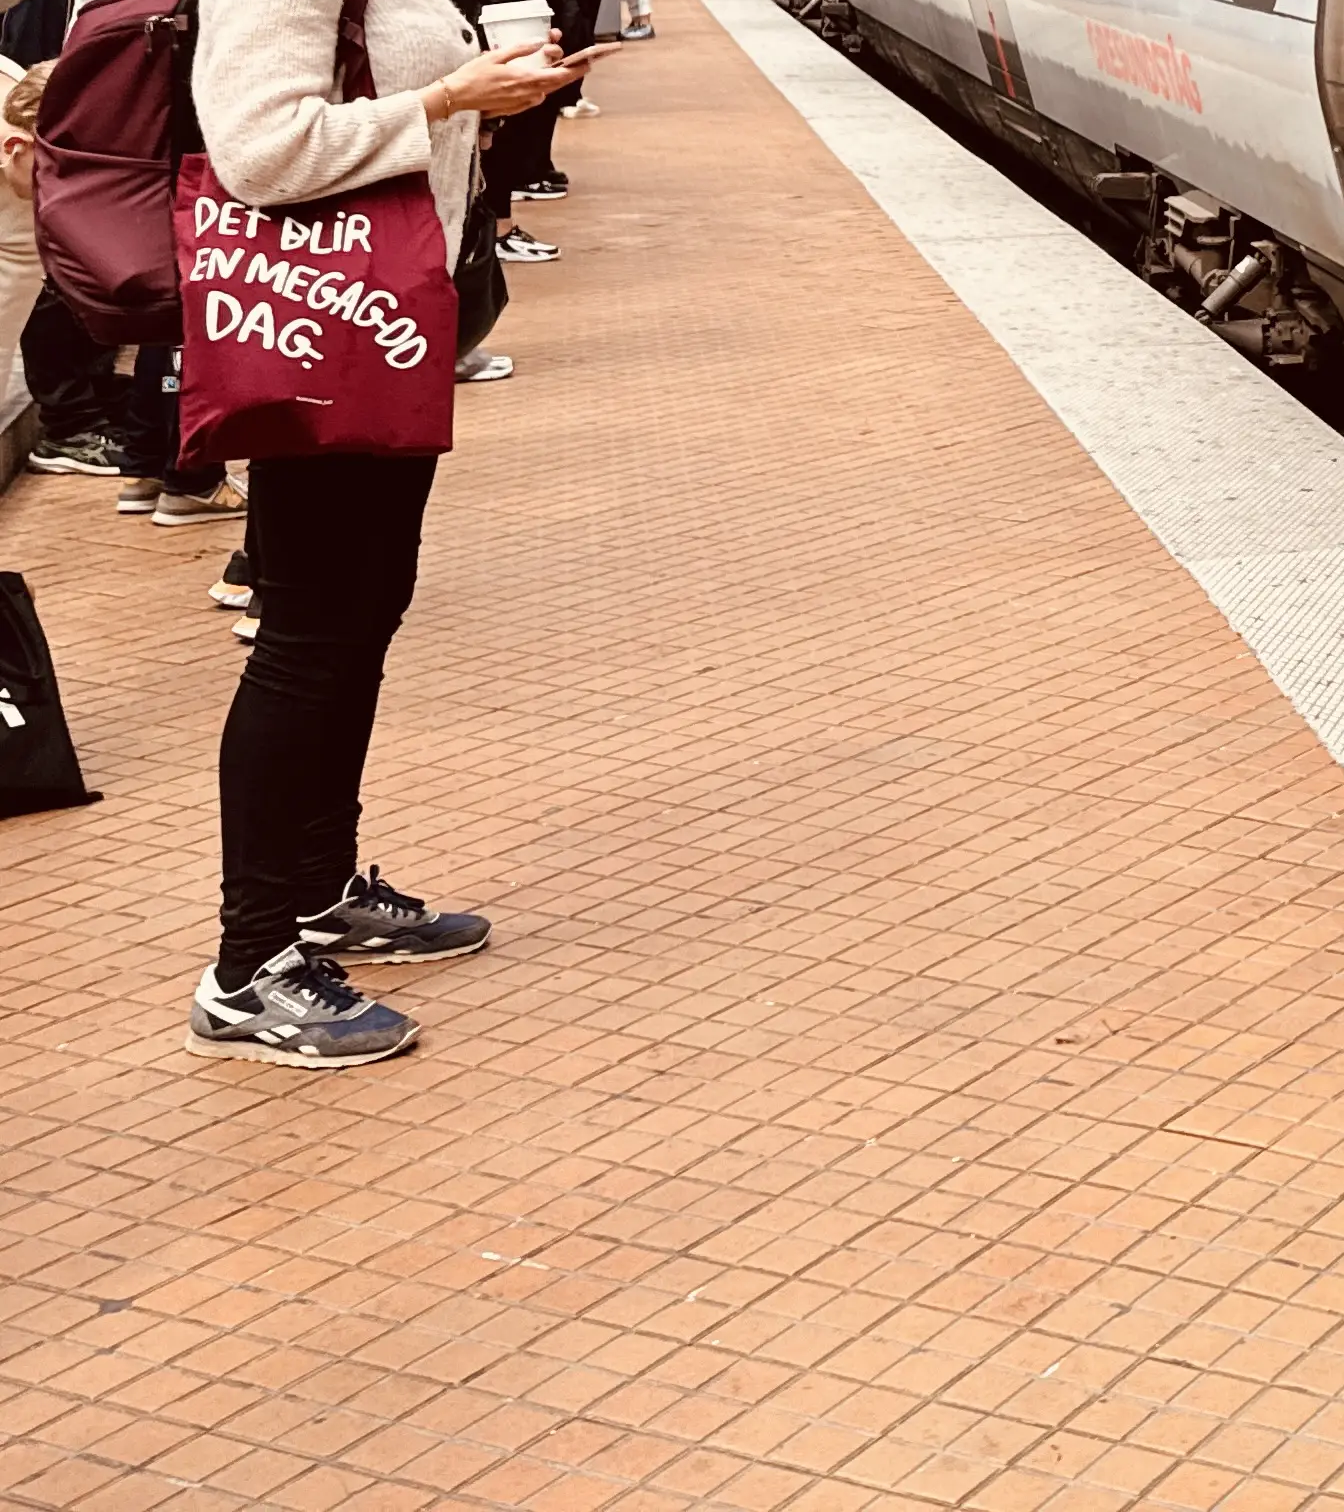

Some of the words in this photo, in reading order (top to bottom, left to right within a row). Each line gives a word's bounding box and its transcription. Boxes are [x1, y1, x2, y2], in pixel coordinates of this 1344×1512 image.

[194, 196, 271, 238] DET
[280, 211, 373, 255] BLIR
[189, 247, 246, 281] EN
[244, 252, 428, 370] MEGAGOD
[205, 290, 324, 370] DAG.
